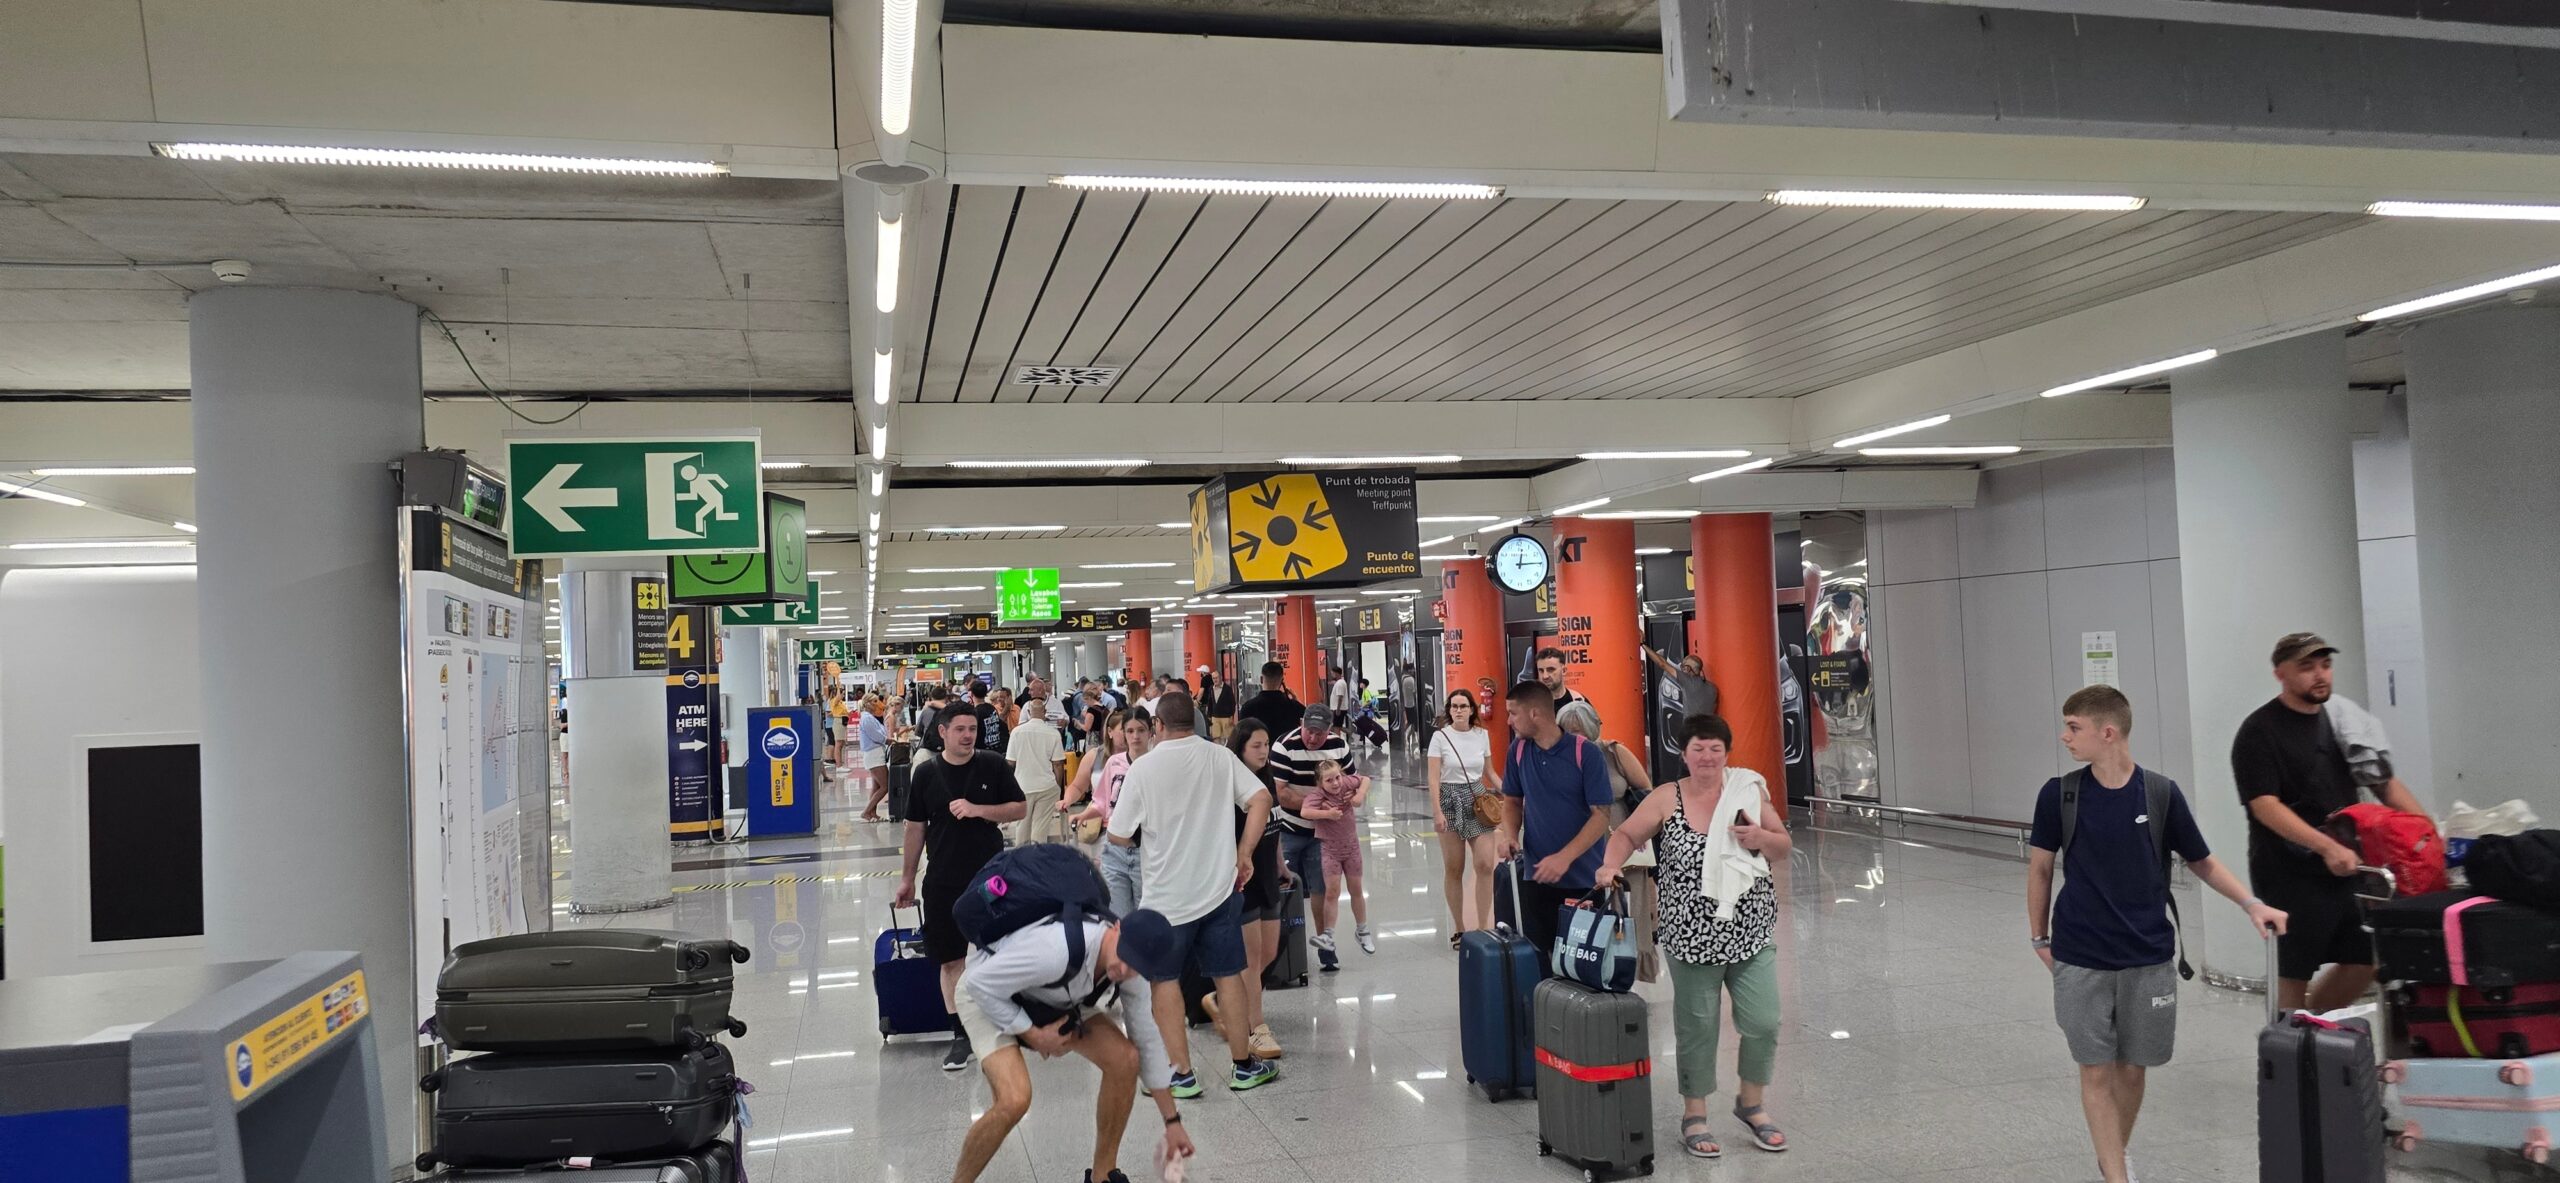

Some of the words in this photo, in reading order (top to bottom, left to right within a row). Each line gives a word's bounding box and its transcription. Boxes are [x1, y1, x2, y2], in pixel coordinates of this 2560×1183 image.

[1325, 477, 1351, 486] Punt
[1354, 476, 1367, 485] de
[1370, 476, 1410, 485] trobada
[1357, 489, 1389, 499] Meeting
[1391, 488, 1411, 498] point
[1372, 501, 1412, 511] Treffpunkt
[1367, 551, 1398, 561] Punto
[1402, 551, 1415, 560] de
[1362, 565, 1415, 575] encuentro
[1118, 613, 1128, 626] C
[1561, 616, 1592, 631] SIGN
[667, 614, 695, 658] 4
[1561, 634, 1592, 646] GREAT
[678, 704, 705, 715] ATM
[676, 717, 708, 728] HERE
[781, 763, 788, 777] 24
[775, 779, 783, 803] cash
[1570, 926, 1588, 939] THE
[1576, 948, 1598, 962] BAG
